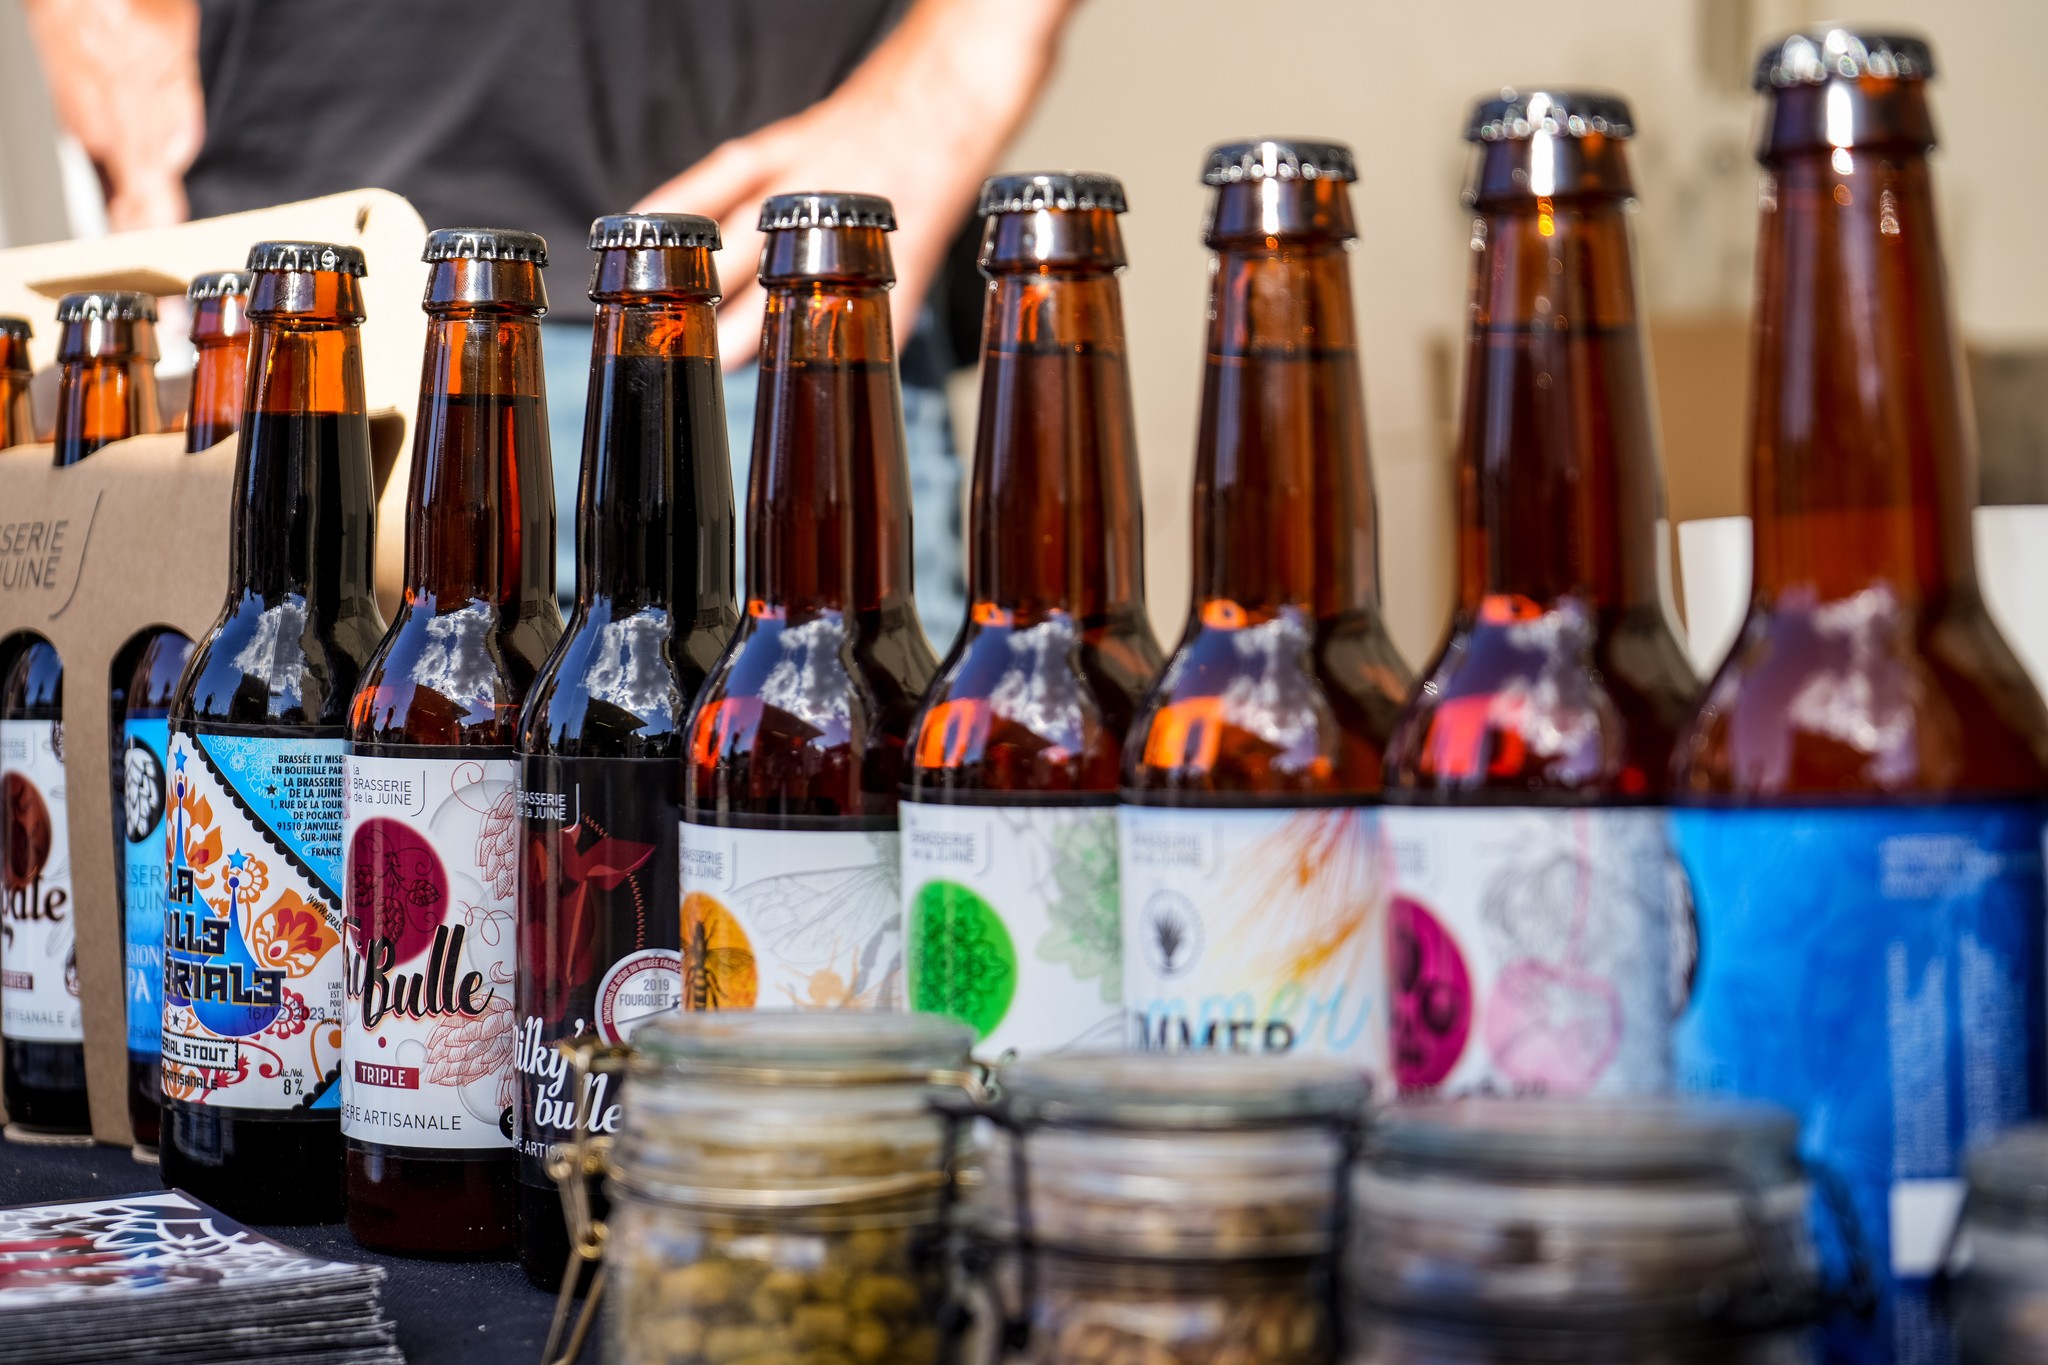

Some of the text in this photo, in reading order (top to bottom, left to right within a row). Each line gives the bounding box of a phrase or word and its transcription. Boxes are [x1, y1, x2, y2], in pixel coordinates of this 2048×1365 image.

[0, 520, 69, 556] SERIE
[0, 555, 60, 592] UINE
[278, 753, 343, 764] BRASSÉE ET MISE
[272, 766, 343, 775] EN BOUTEILLE PAR
[353, 764, 360, 775] la
[284, 777, 343, 787] LA BRASSERIE
[353, 777, 412, 793] BRASSERIE
[289, 788, 342, 798] DE LA JUINE
[353, 791, 412, 806] de la JUINE
[270, 800, 343, 810] 1, RUE DE LA TOUR
[293, 811, 343, 820] DE POCANCY
[534, 806, 567, 821] JUINE
[277, 822, 342, 831] 91510 JANVILLE-
[300, 833, 342, 842] SUR-JUINE
[311, 847, 341, 857] FRANCE
[168, 859, 194, 905] LA
[608, 981, 618, 992] DE
[644, 979, 670, 991] 2019
[330, 990, 340, 999] EST
[619, 994, 670, 1006] FOURQUET
[184, 1043, 229, 1063] STOUT
[283, 1079, 304, 1095] 8 %
[535, 1072, 623, 1134] bulle
[342, 1099, 462, 1132] ÈRE ARTISANALE
